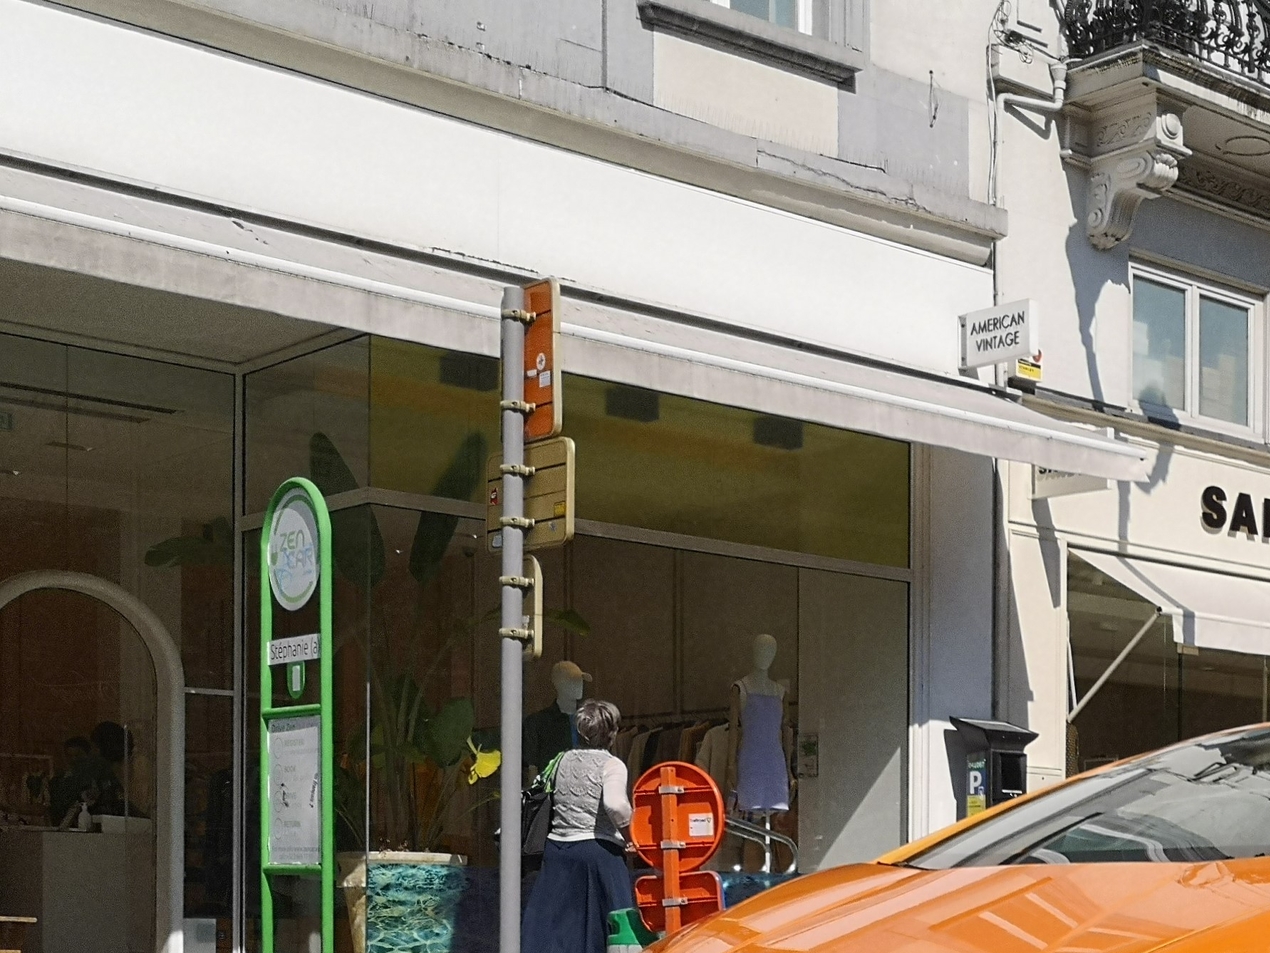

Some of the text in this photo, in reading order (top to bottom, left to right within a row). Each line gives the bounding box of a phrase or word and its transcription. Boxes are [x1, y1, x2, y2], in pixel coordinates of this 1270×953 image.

[970, 310, 1025, 336] AMERICAN
[976, 331, 1020, 352] VINTAGE
[271, 639, 308, 661] Stéphanie
[970, 771, 982, 794] P
